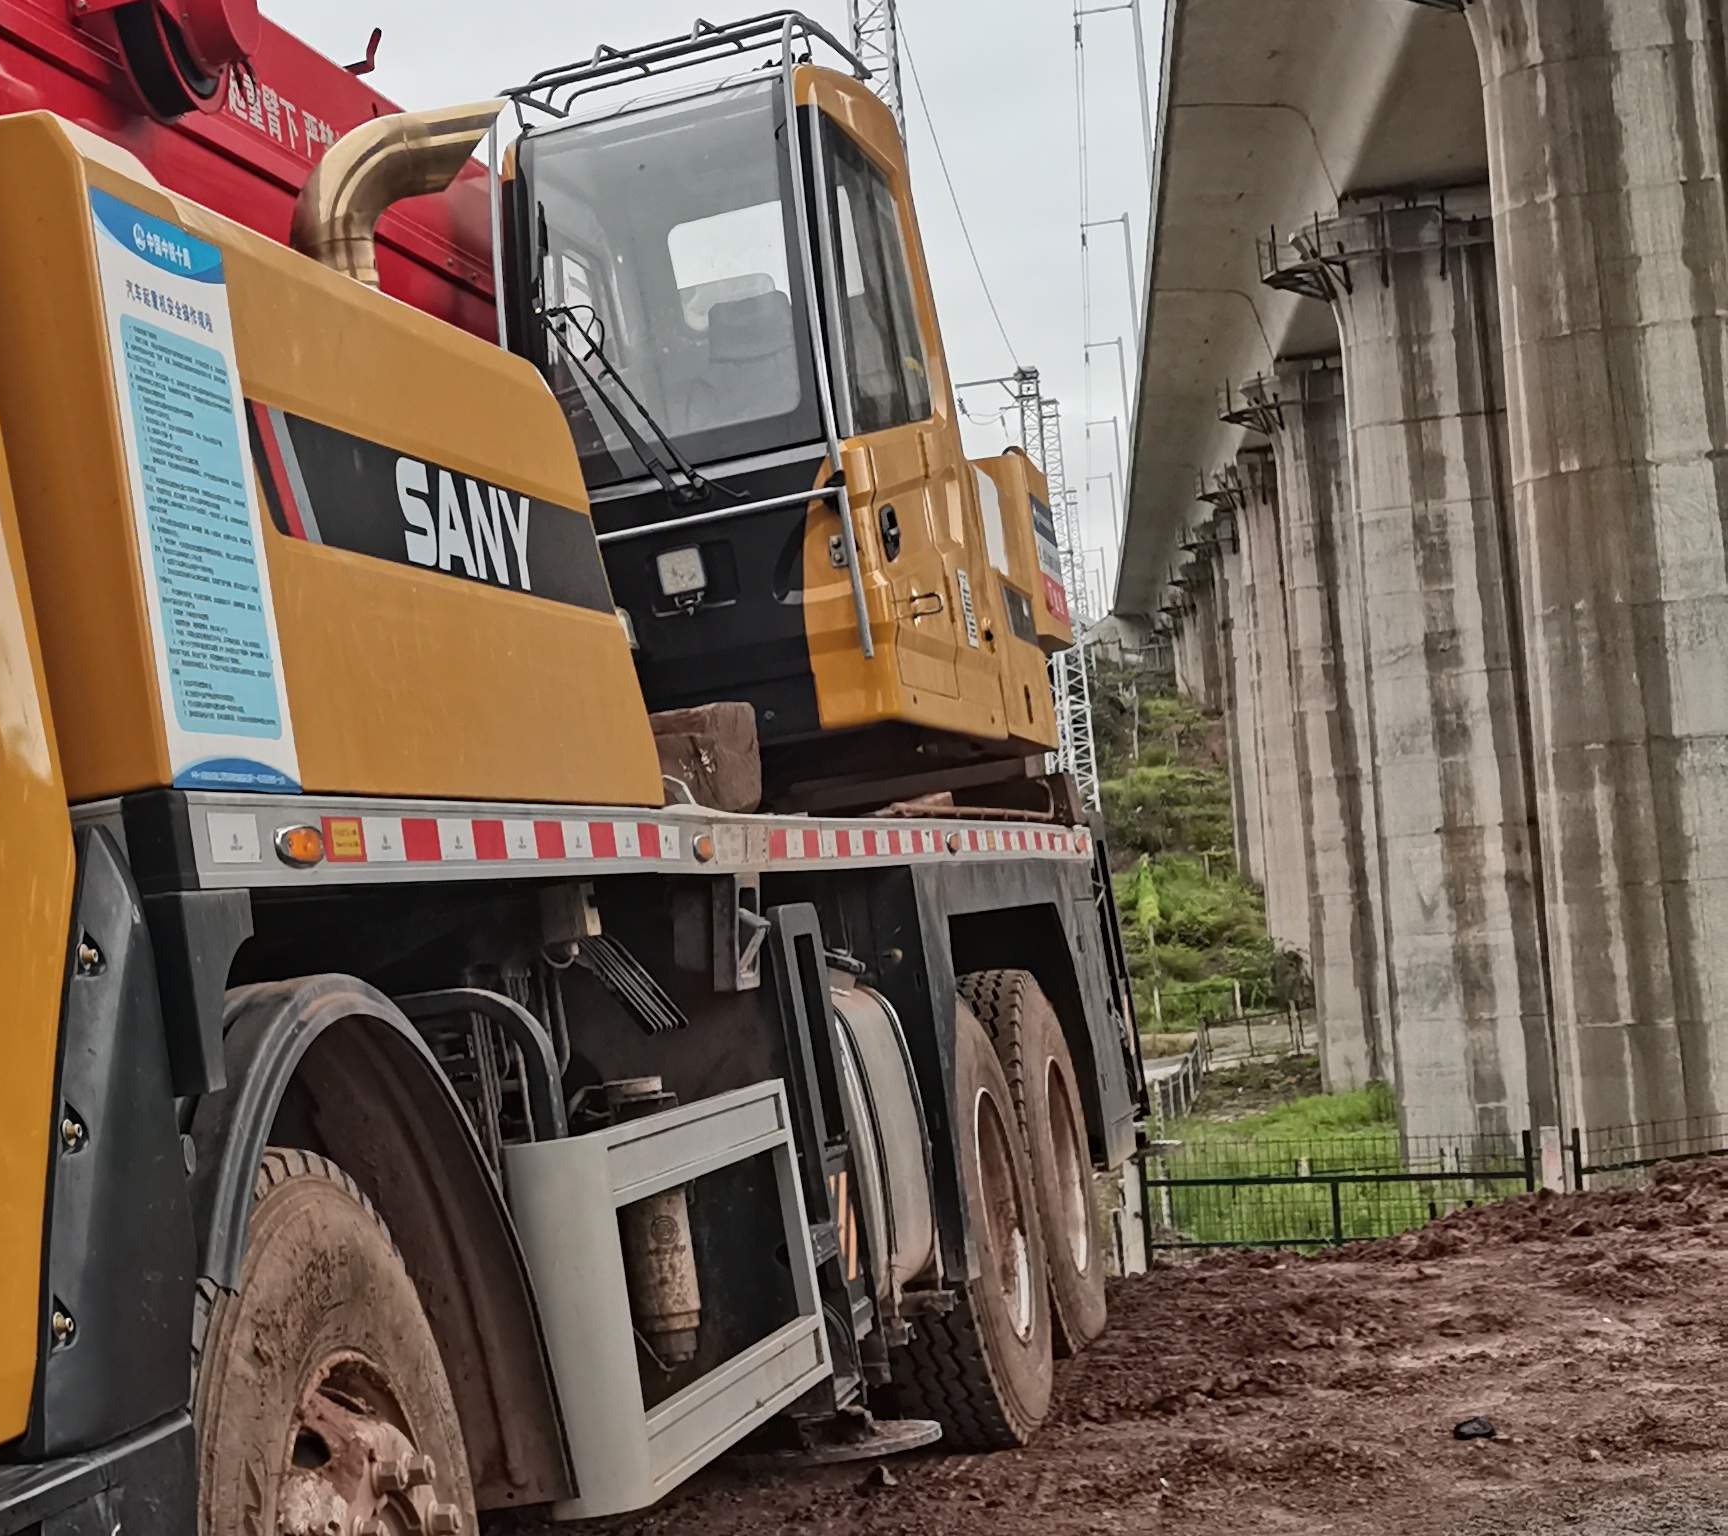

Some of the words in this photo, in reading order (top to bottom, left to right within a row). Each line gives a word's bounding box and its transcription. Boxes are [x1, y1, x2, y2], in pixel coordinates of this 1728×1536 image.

[125, 279, 214, 334] 汽车起重机安全操作规程
[395, 456, 532, 591] SANY
